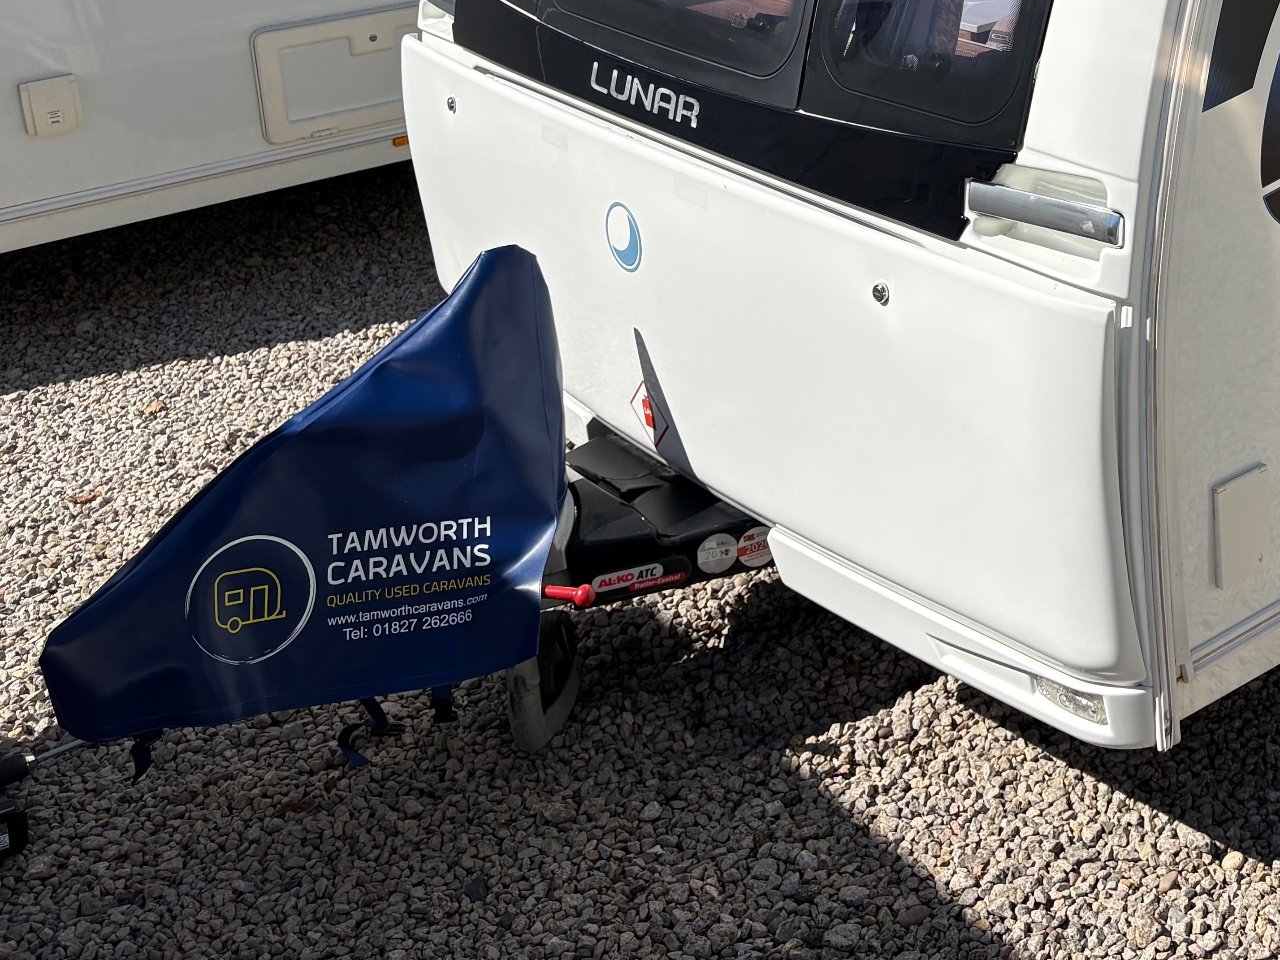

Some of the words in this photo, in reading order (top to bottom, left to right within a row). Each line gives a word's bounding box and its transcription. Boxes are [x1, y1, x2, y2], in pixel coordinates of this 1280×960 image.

[590, 61, 700, 129] LUNAR
[327, 515, 491, 555] TAMWORTH
[327, 543, 491, 586] CARAVANS
[598, 573, 635, 588] AL-KO
[637, 566, 657, 580] ATC
[326, 589, 382, 608] QUALITY
[385, 584, 420, 599] USED
[423, 574, 491, 594] CARAVANS
[327, 593, 488, 626] www.tamworthcaravans.com
[343, 626, 368, 641] Tel:
[372, 619, 417, 637] 01827
[422, 609, 472, 630] 262666
